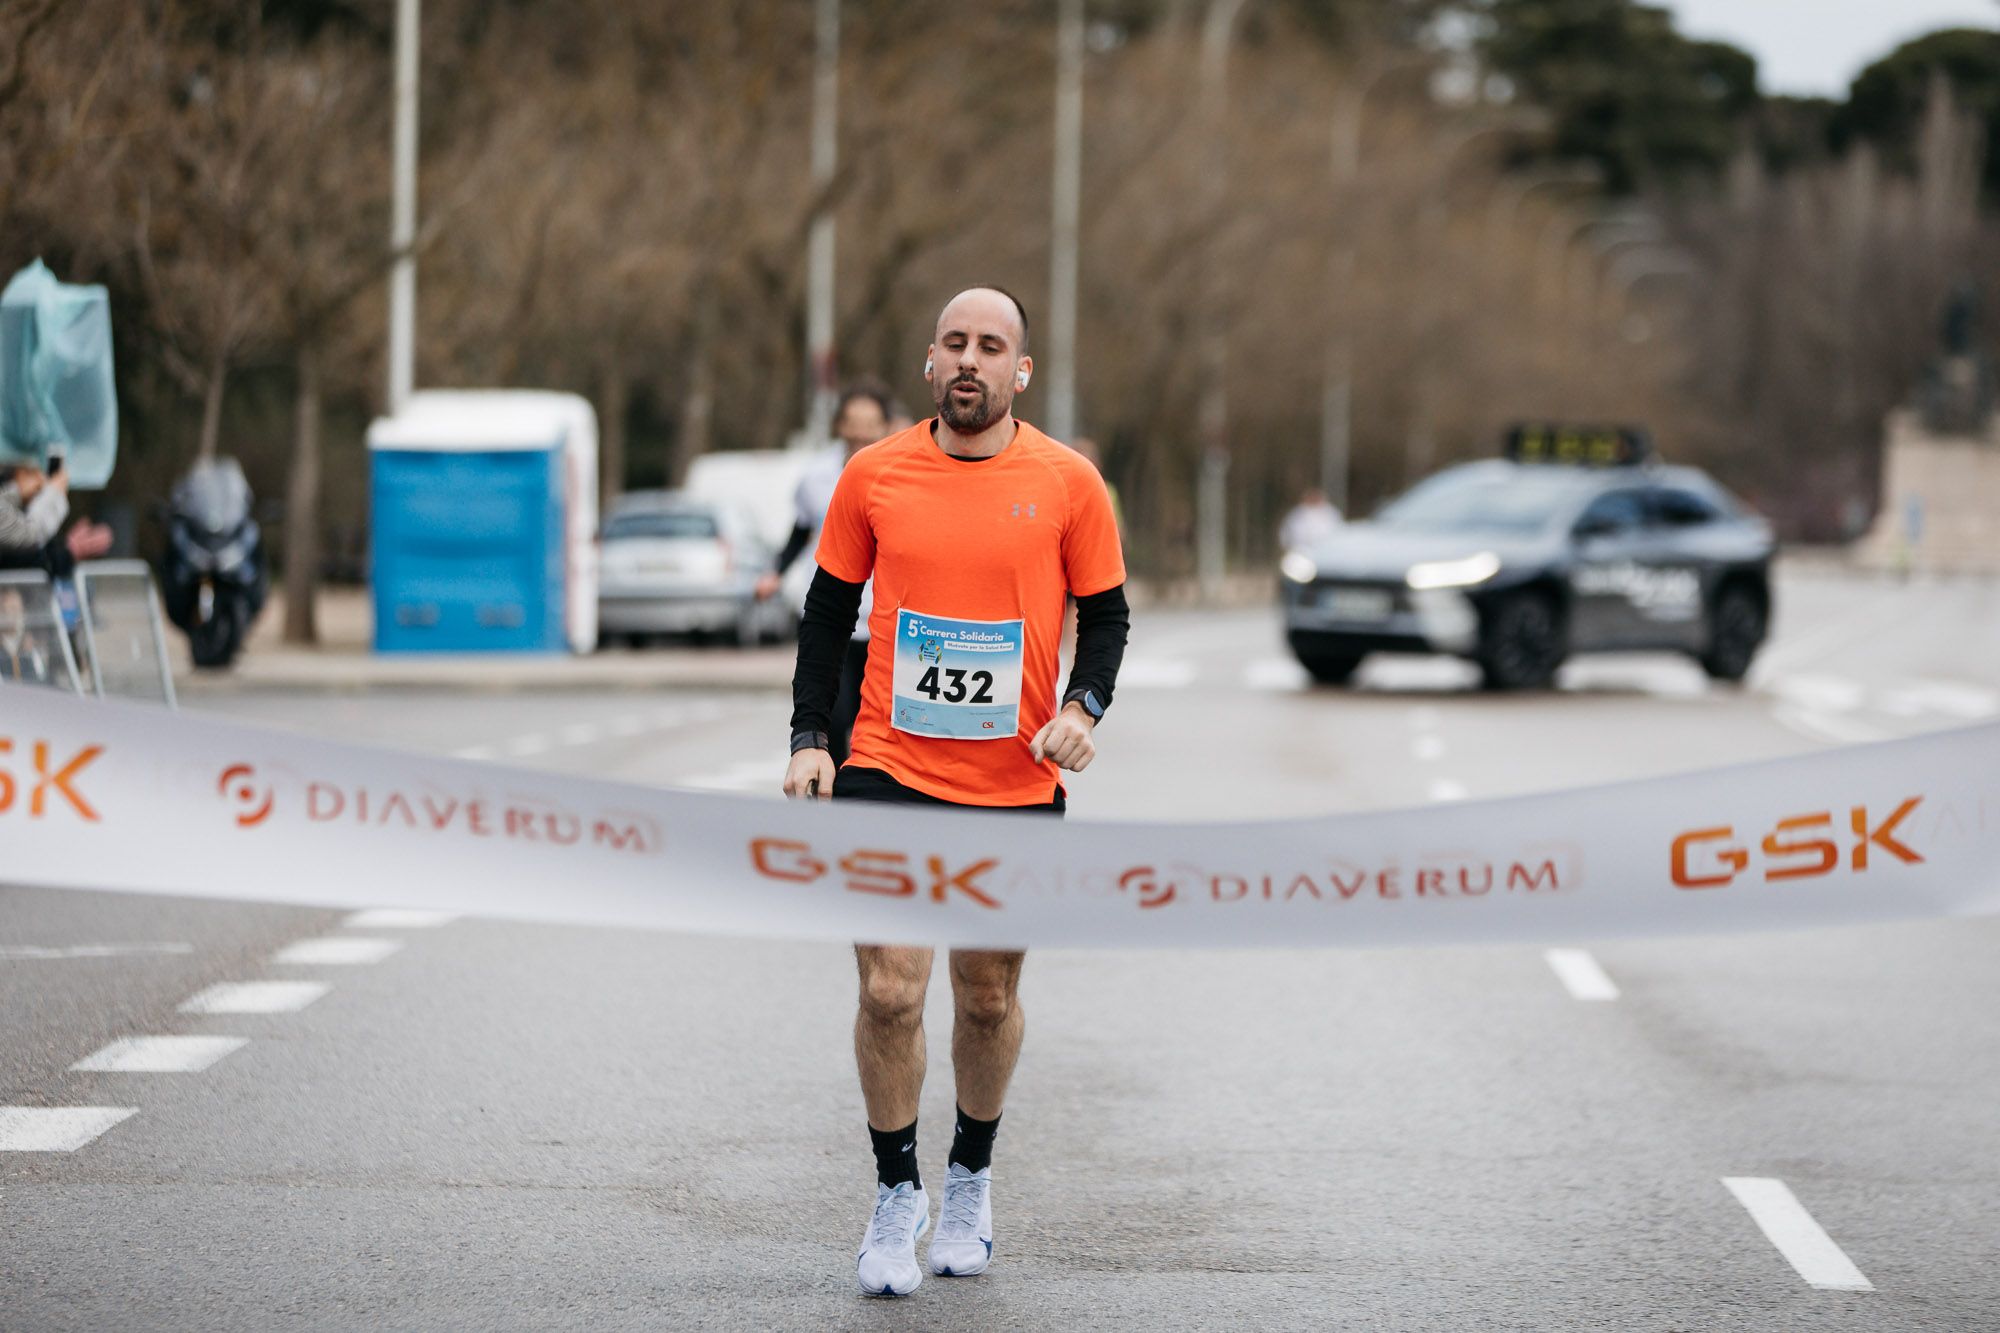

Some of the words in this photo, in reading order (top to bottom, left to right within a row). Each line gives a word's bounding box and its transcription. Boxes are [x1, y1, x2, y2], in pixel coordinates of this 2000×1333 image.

[920, 625, 957, 640] Carrera
[960, 630, 1004, 642] Solidaria
[916, 666, 993, 703] 432
[306, 781, 648, 853] DIAVERUM
[749, 836, 1003, 910] GSK
[1212, 859, 1560, 903] DIAVERUM
[1670, 795, 1926, 892] GSK
